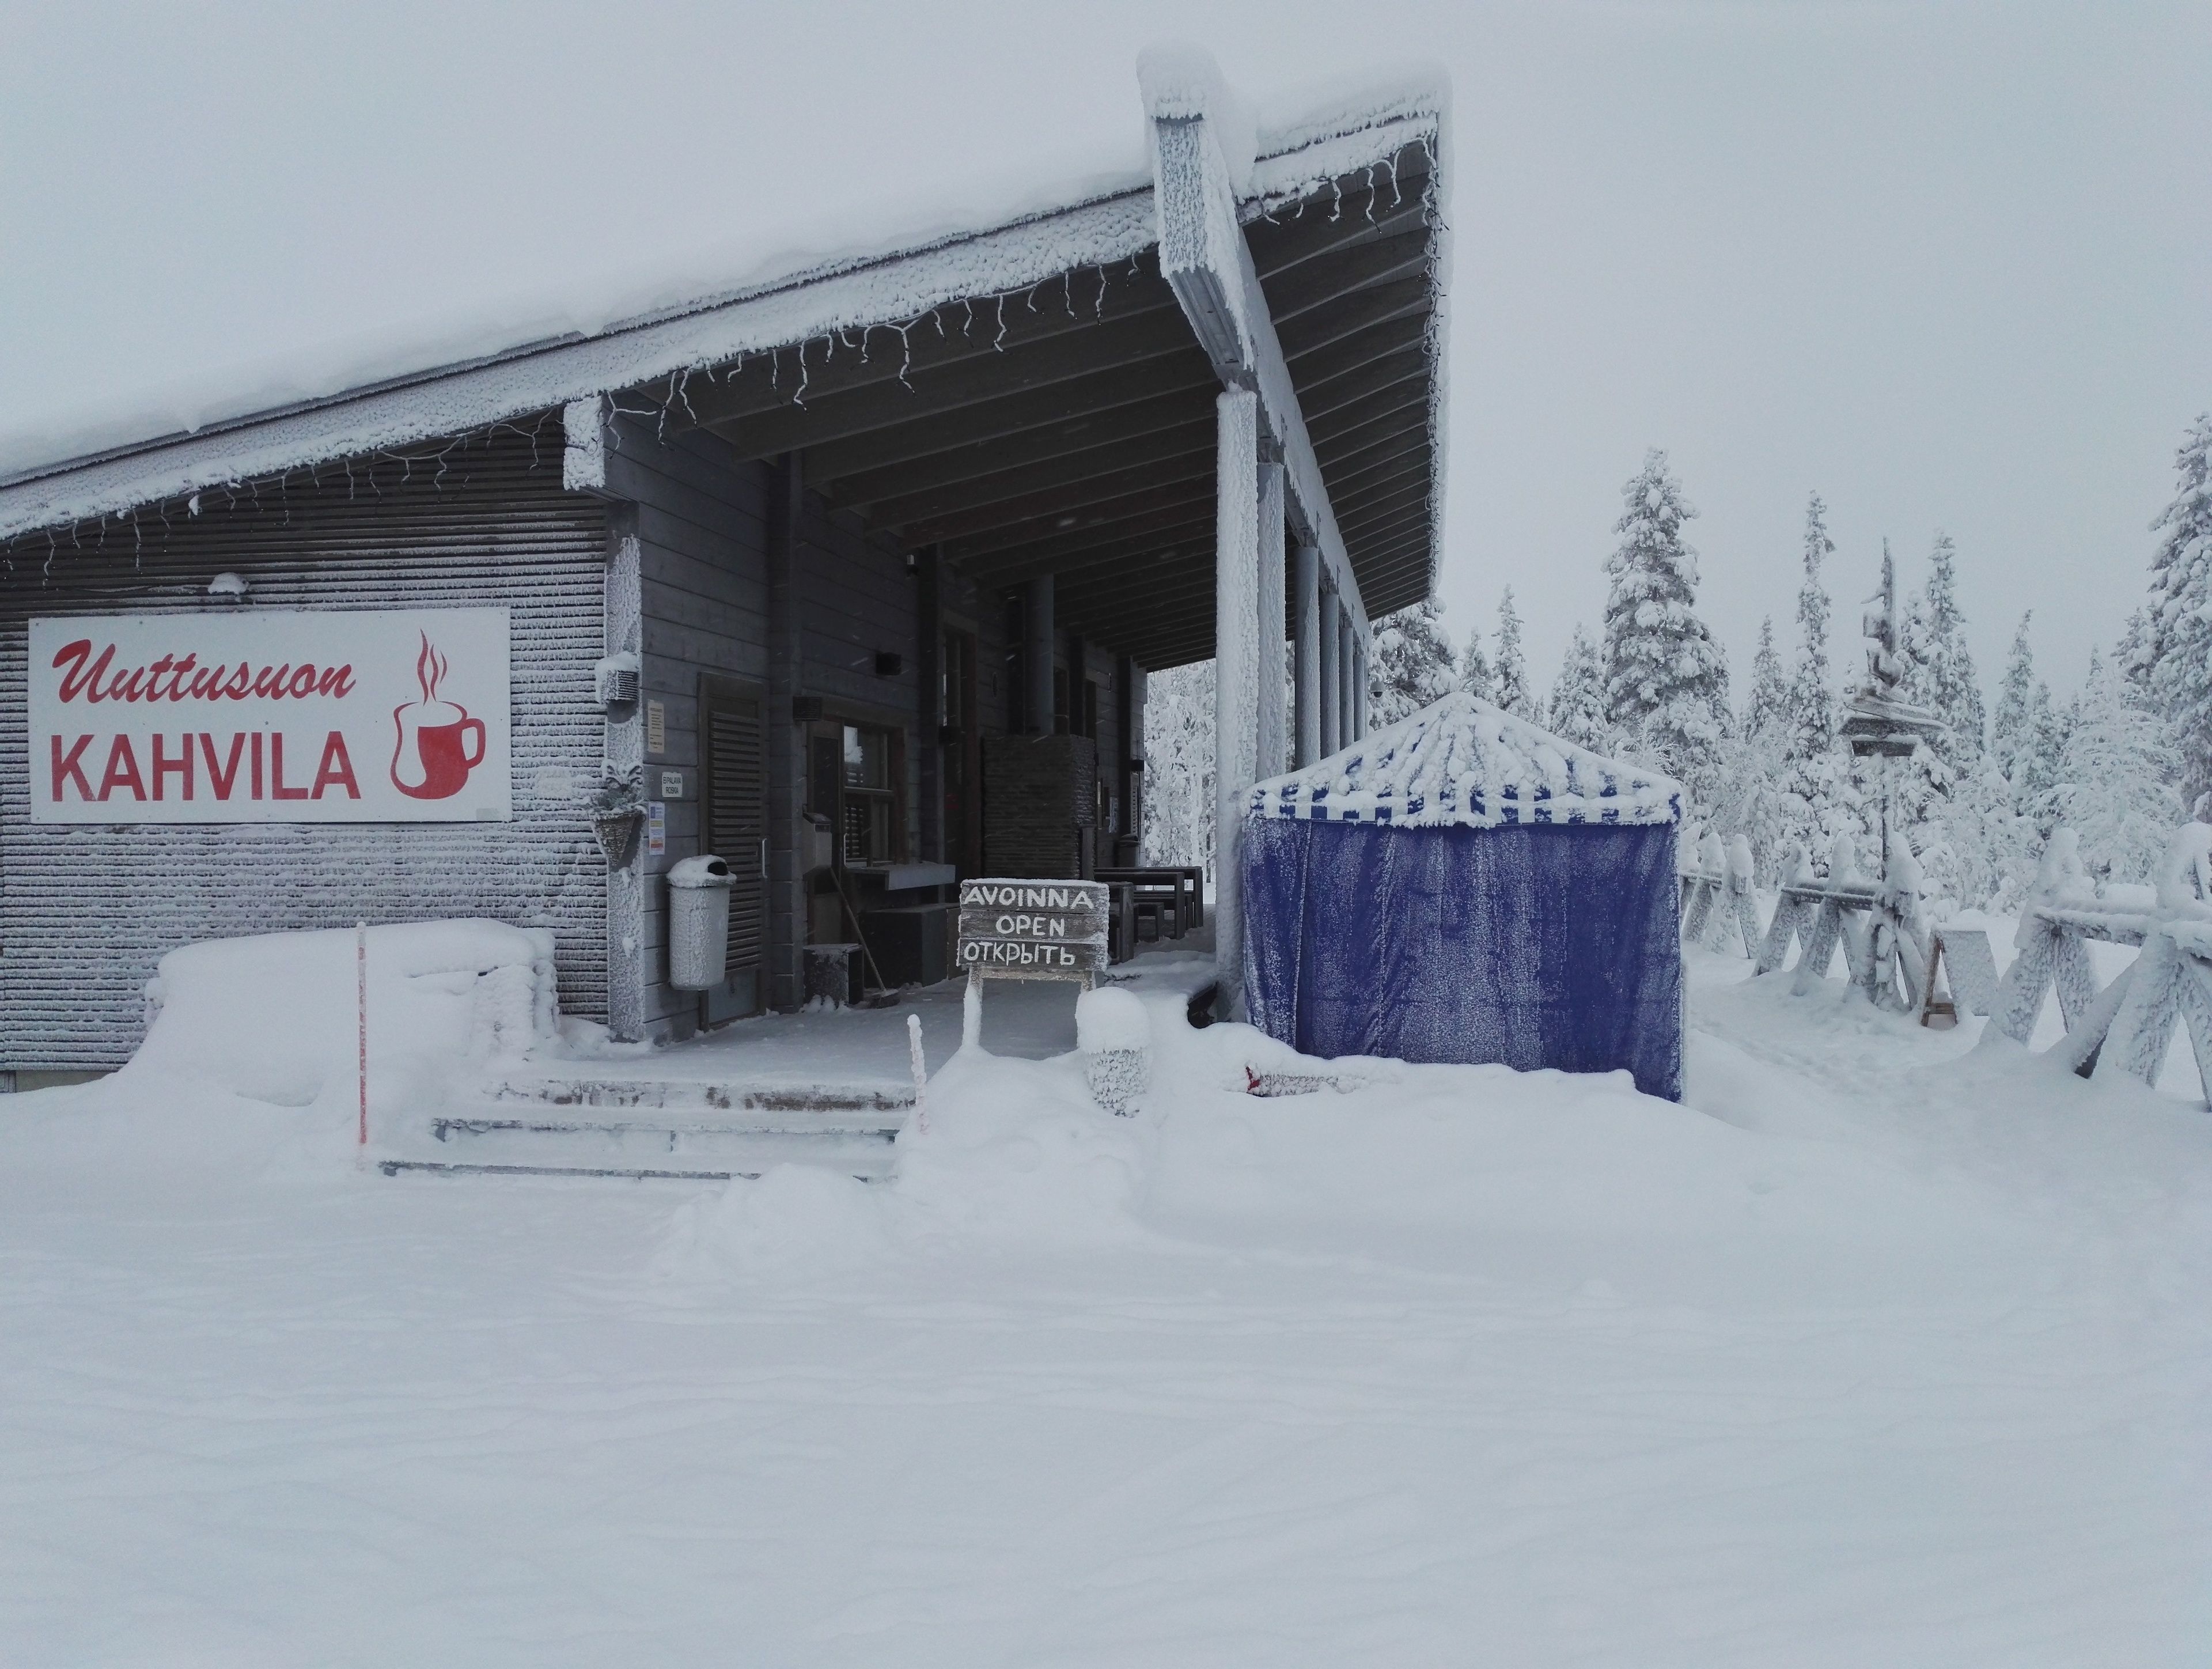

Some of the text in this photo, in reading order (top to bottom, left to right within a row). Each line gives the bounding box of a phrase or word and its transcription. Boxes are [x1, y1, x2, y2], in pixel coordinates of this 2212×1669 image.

[51, 731, 361, 802] KAHVILA
[964, 886, 1094, 909] AVOINNA
[995, 915, 1065, 937] OPEN
[964, 942, 1076, 966] ОТКРЫТЬ
